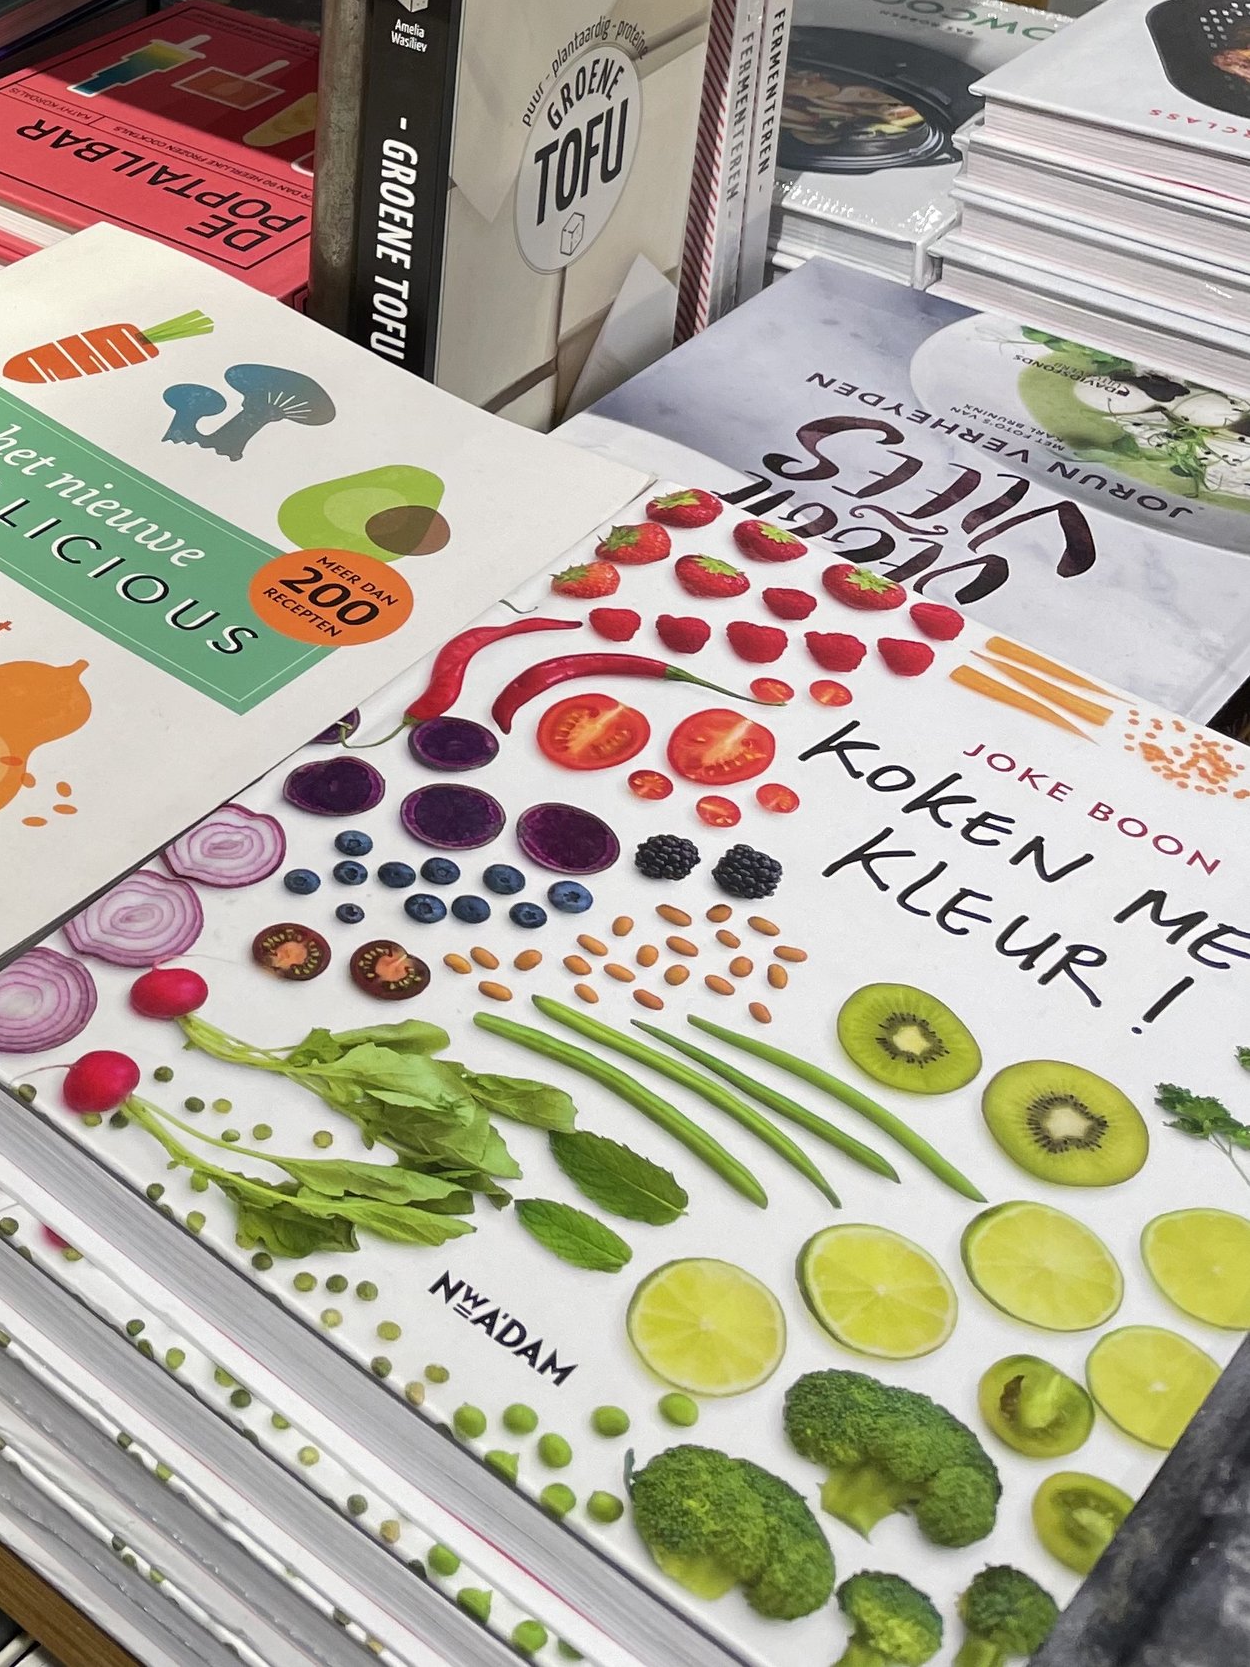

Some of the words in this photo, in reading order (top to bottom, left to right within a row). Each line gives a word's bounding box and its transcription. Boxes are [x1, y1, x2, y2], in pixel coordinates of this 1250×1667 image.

[391, 30, 427, 53] Wasiliev
[395, 19, 425, 38] Amelia
[522, 83, 545, 128] puur
[551, 15, 611, 77] plantaardig
[547, 57, 625, 132] GROENE
[758, 7, 787, 176] FERMENTEREN
[62, 105, 92, 121] KATHY
[113, 126, 166, 147] COCKTAILS
[16, 119, 307, 234] POPTAILBAR
[167, 143, 211, 163] FROZEN
[534, 97, 629, 226] TOFU
[376, 137, 418, 270] GROENE
[185, 214, 273, 252] DE
[370, 275, 410, 360] TOFU
[805, 372, 1029, 462] VERHEYDEN
[950, 407, 979, 421] VAN
[964, 404, 1025, 430] BRUNINX
[983, 417, 1032, 440] FOTO'S
[1027, 425, 1063, 443] KARL
[1034, 434, 1065, 451] MET
[1047, 461, 1193, 518] JORUN
[45, 472, 205, 567] nieuwe
[279, 566, 380, 626] 200
[316, 556, 361, 585] MEER
[360, 582, 399, 607] DAN
[263, 587, 343, 638] RECEPTEN
[798, 720, 1094, 883] KOKEN
[963, 743, 1073, 803] JOKE
[1087, 801, 1222, 876] BOON
[821, 827, 1108, 1008] KLEUR
